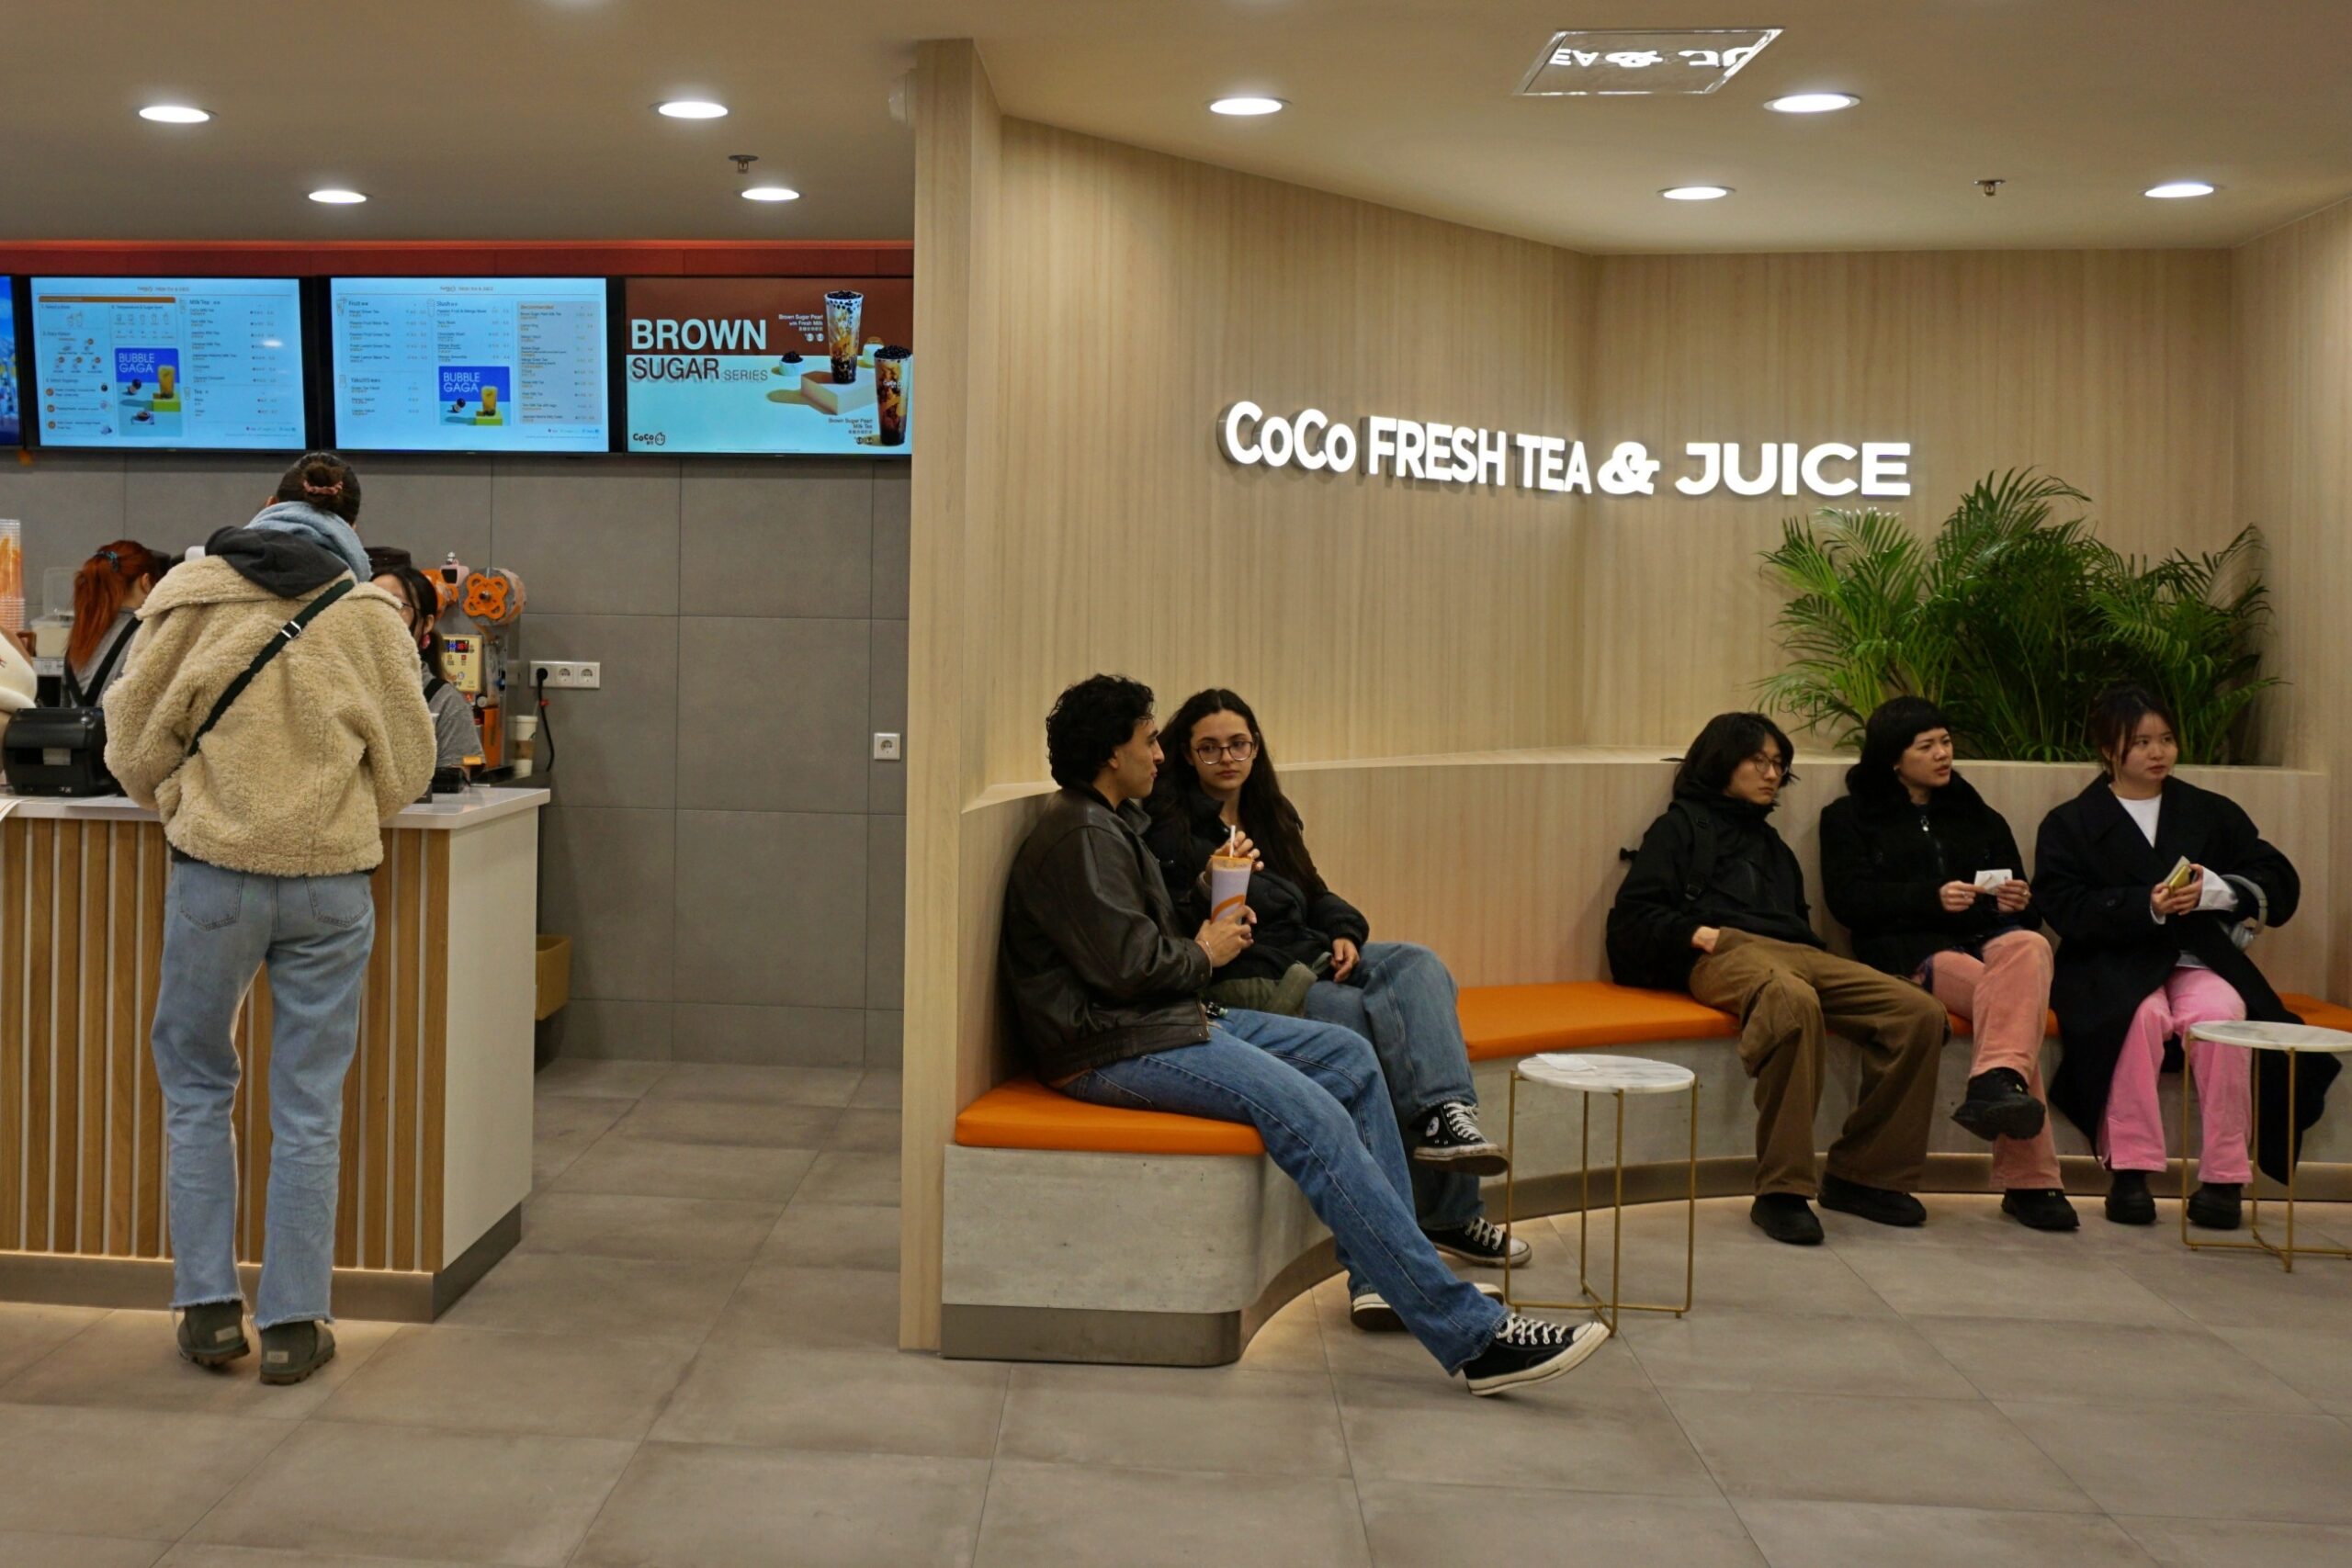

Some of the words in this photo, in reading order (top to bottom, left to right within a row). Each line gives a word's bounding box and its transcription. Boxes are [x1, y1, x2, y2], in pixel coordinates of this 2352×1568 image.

[631, 319, 767, 351] BROWN
[119, 353, 154, 363] BUBBLE
[119, 363, 153, 373] GAGA
[631, 357, 719, 379] SUGAR
[724, 369, 768, 381] SERIES
[443, 372, 481, 382] BUBBLE
[443, 382, 479, 393] GAGA
[633, 433, 654, 442] CoCo
[1222, 400, 1357, 472] CoCo
[1366, 415, 1507, 486] FRESH
[1516, 433, 1592, 493] TEA
[1597, 441, 1660, 495] &
[1675, 442, 1911, 496] JUICE
